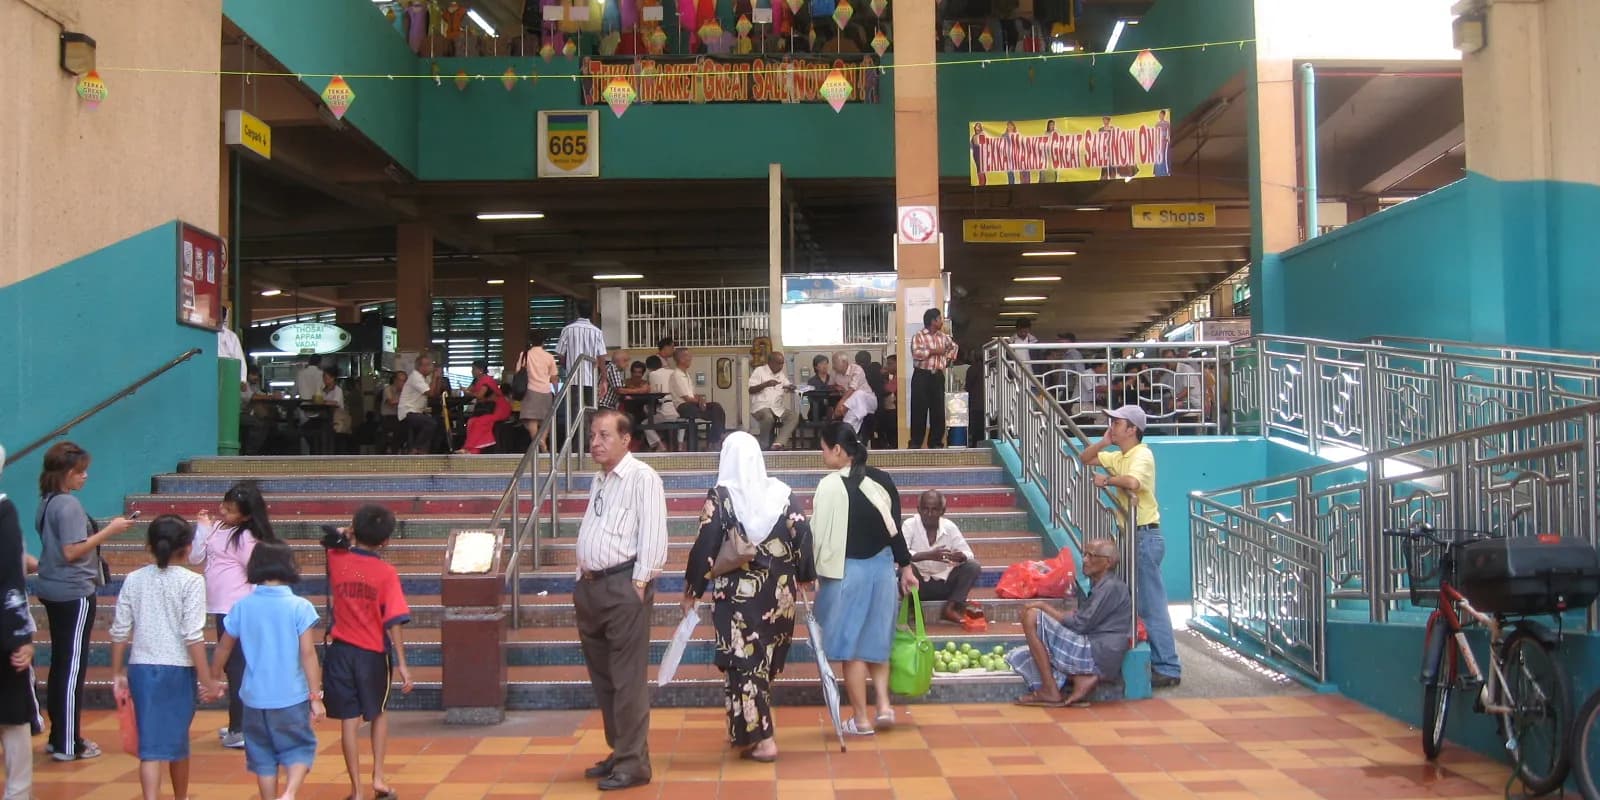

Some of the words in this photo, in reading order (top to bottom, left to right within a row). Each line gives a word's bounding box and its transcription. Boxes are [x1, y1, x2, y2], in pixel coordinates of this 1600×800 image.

[640, 59, 700, 102] MARKET
[702, 59, 750, 101] GREAT
[752, 58, 788, 101] SALE
[793, 59, 830, 100] NOW
[549, 135, 587, 156] 665
[978, 134, 1008, 173] TEKKA
[1011, 133, 1048, 171] MARKET
[1050, 131, 1083, 169] GREAT
[1084, 129, 1110, 168] SALE
[1111, 127, 1137, 167] NOW
[1159, 209, 1206, 225] Shops
[295, 333, 322, 341] APPAM
